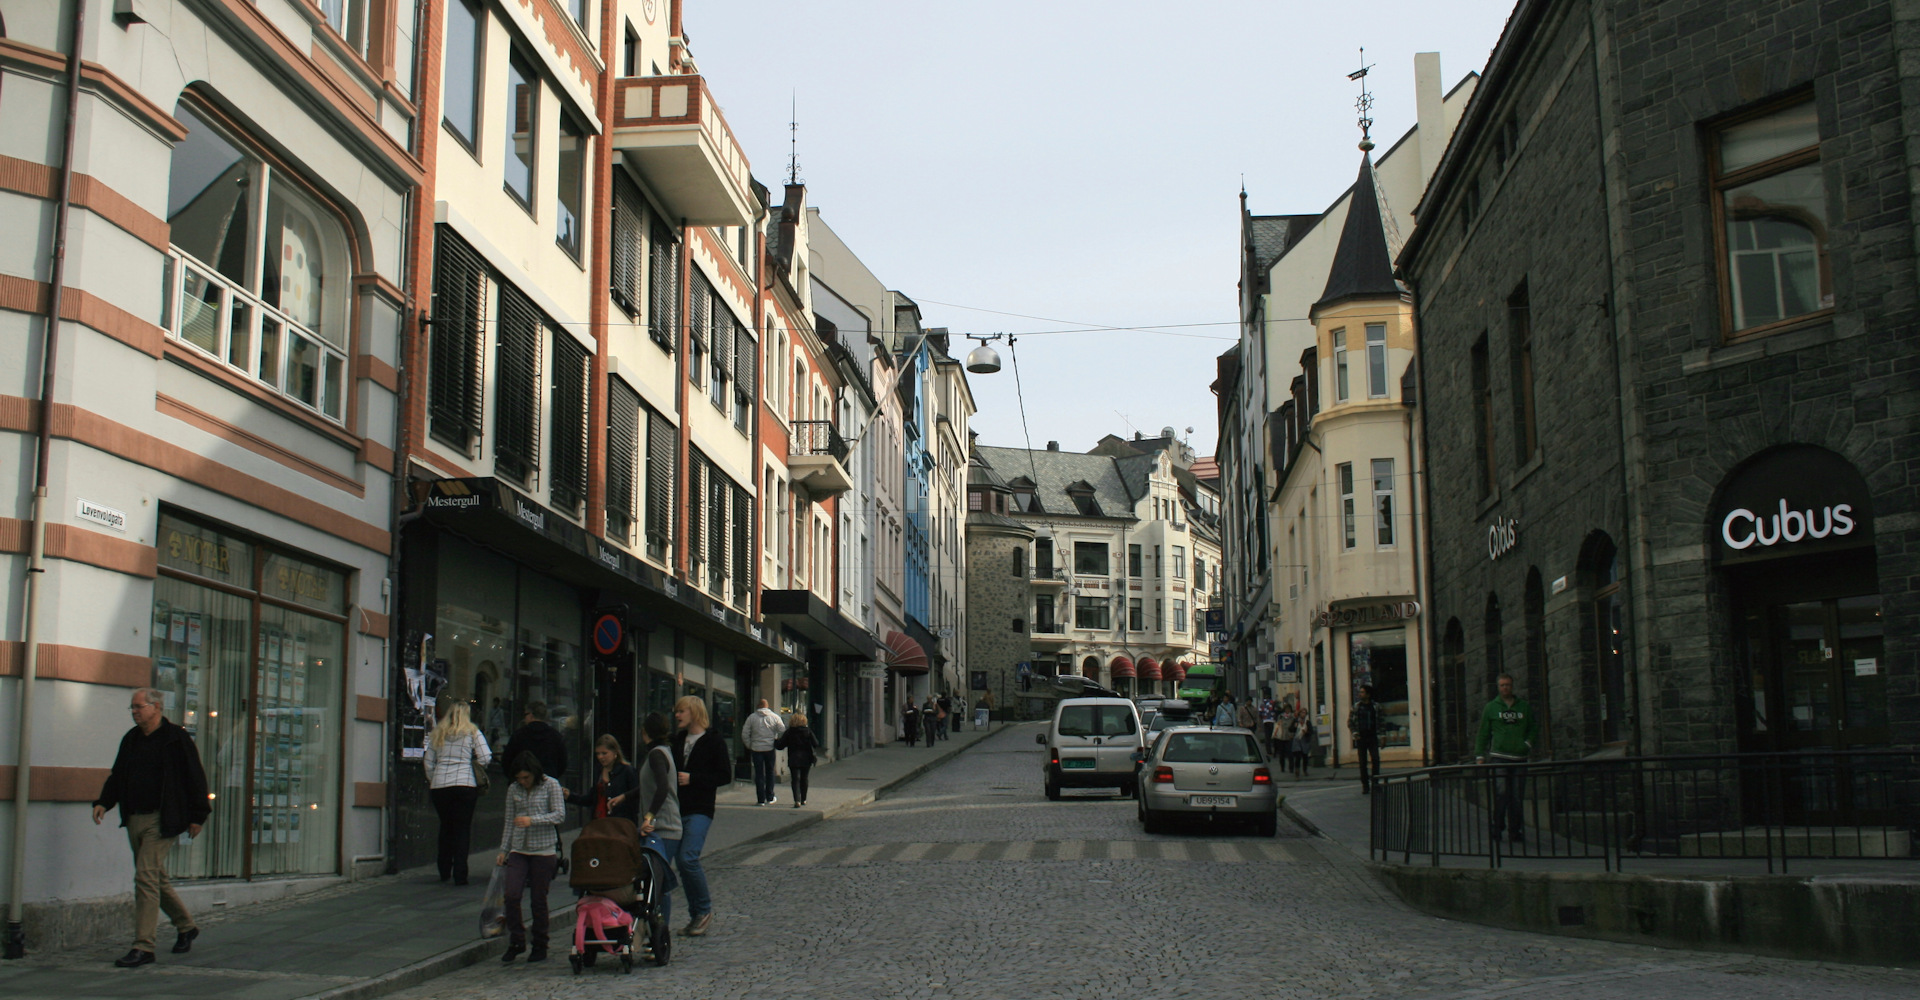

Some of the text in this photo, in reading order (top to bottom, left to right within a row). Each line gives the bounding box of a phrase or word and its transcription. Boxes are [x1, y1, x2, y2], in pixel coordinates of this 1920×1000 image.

[427, 495, 480, 509] Mestergull
[517, 500, 544, 530] Mestergull
[1489, 515, 1516, 561] Cubus
[1722, 498, 1855, 550] Cubus
[184, 535, 230, 575] NOTAR
[290, 568, 328, 602] NOTAR
[1320, 601, 1417, 627] SPONLAND
[1282, 656, 1292, 671] P
